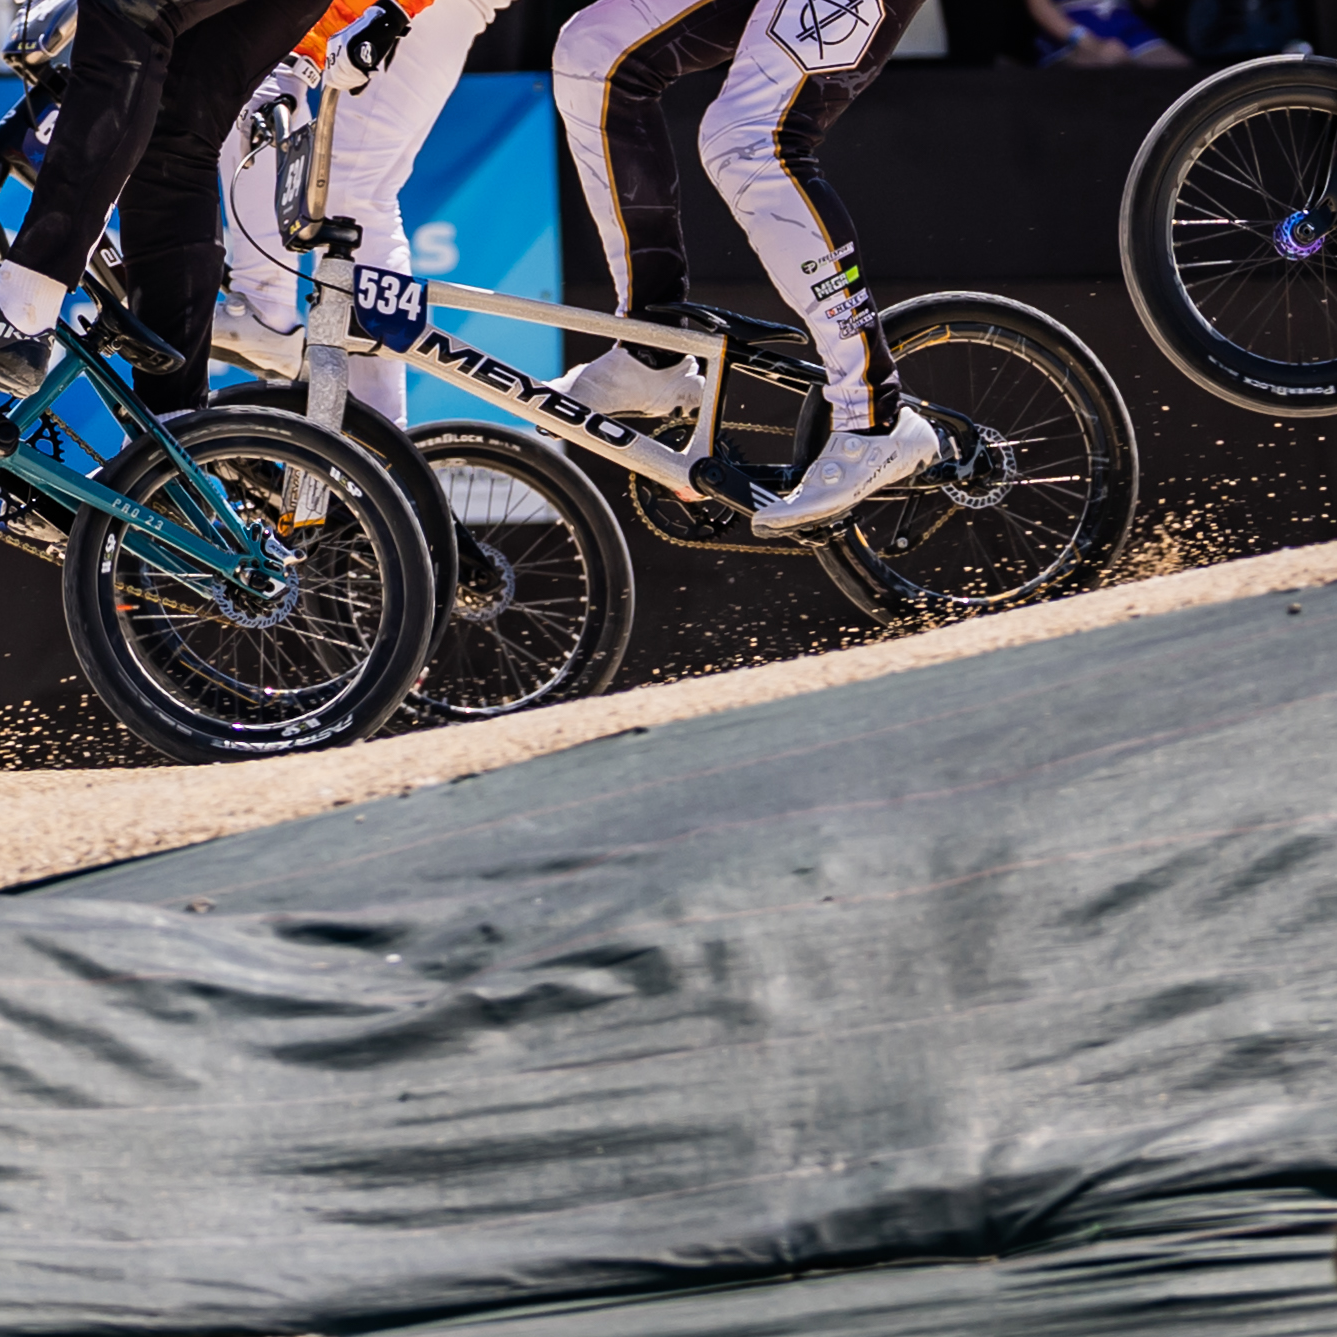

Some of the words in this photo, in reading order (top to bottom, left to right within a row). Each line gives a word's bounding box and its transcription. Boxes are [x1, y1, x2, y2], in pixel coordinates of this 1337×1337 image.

[357, 270, 422, 322] 534
[412, 329, 639, 450] MEYBO
[111, 497, 141, 519] PRO
